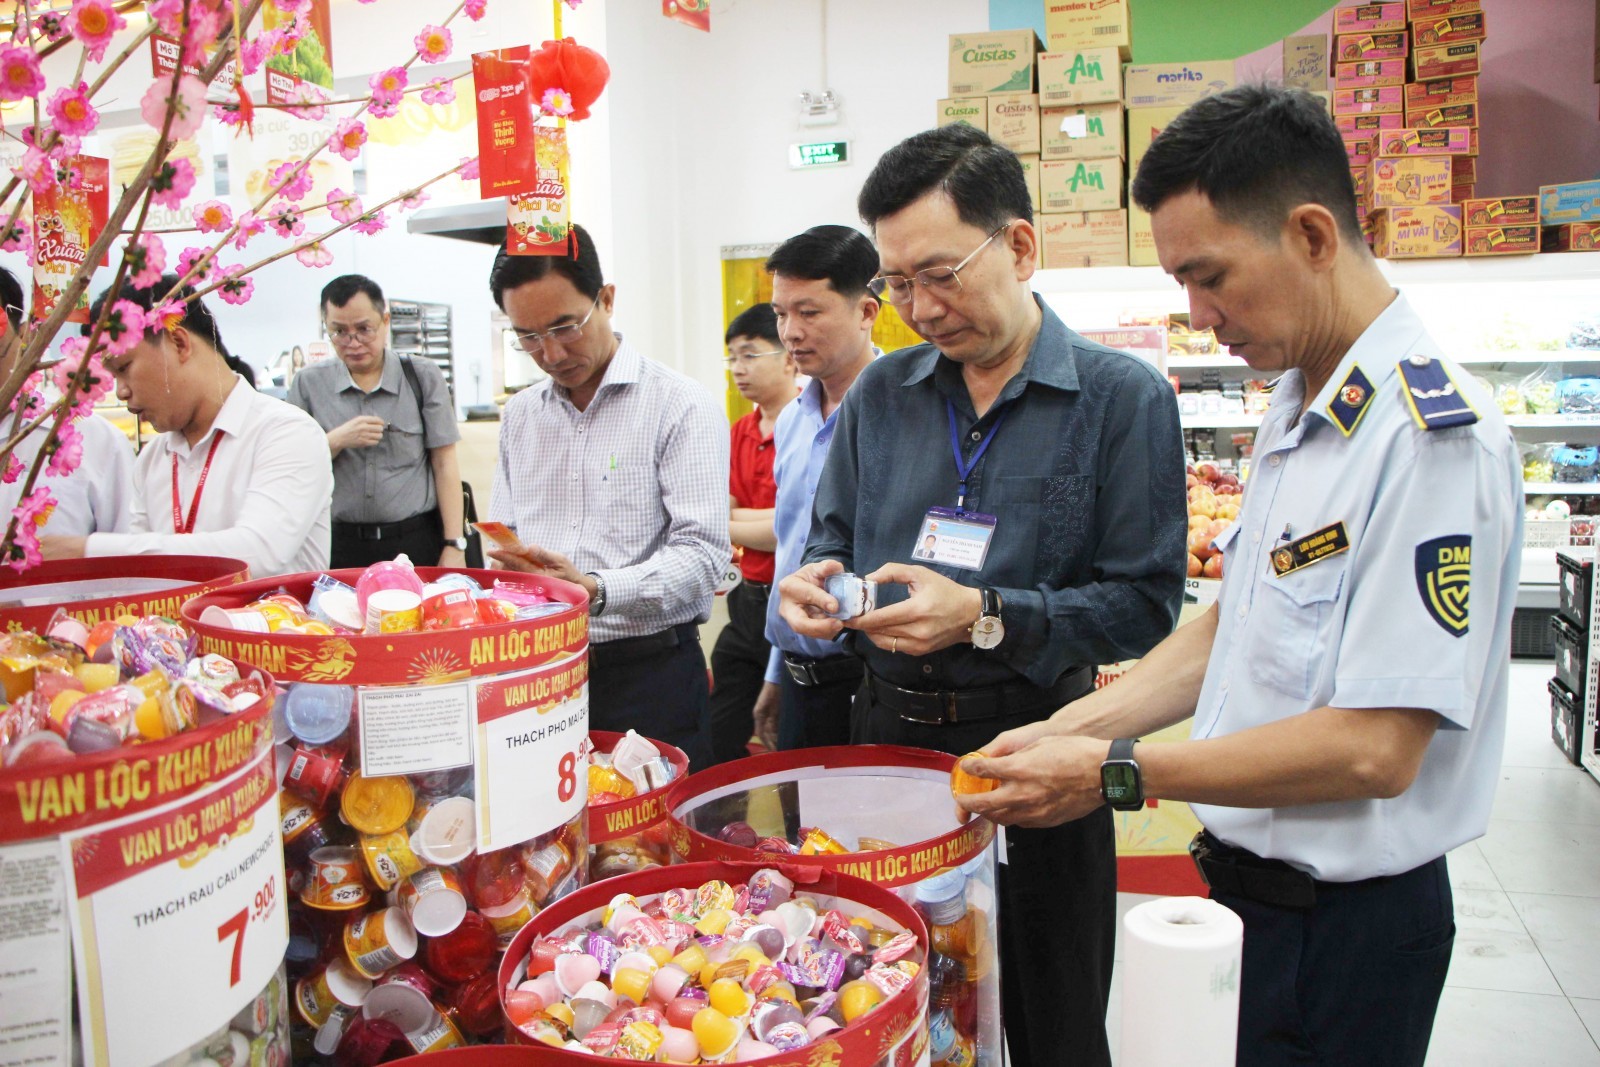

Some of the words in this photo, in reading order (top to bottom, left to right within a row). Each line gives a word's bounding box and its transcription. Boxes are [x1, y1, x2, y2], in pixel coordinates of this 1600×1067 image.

[1050, 3, 1087, 13] mentos
[963, 48, 1017, 64] Custas
[1064, 54, 1104, 84] An
[944, 106, 980, 117] Custas
[996, 102, 1033, 115] Custas
[1065, 162, 1104, 192] An
[38, 239, 86, 265] Xuân
[499, 629, 530, 662] LỘC
[534, 623, 564, 655] KHAI
[504, 684, 528, 707] VẠN
[530, 677, 549, 701] LỘC
[552, 670, 570, 694] KHAI
[506, 728, 545, 749] THACH
[548, 720, 567, 736] PHO
[568, 713, 580, 727] MAI
[16, 771, 86, 823] VẠN
[95, 759, 150, 809] LỘC
[157, 739, 211, 795] KHAI
[557, 751, 577, 803] 8
[120, 827, 162, 867] VẠN
[166, 813, 198, 852] LỘC
[201, 796, 232, 836] KHAI
[605, 807, 634, 833] VẠN
[635, 799, 658, 825] LỘC
[877, 855, 907, 882] LỘC
[911, 844, 944, 875] KHAI
[946, 830, 975, 863] XUÂN
[134, 898, 186, 928] THACH
[189, 882, 215, 906] RAU
[217, 868, 238, 890] CAU
[239, 831, 275, 874] NEWCHOICE
[217, 906, 250, 989] 7
